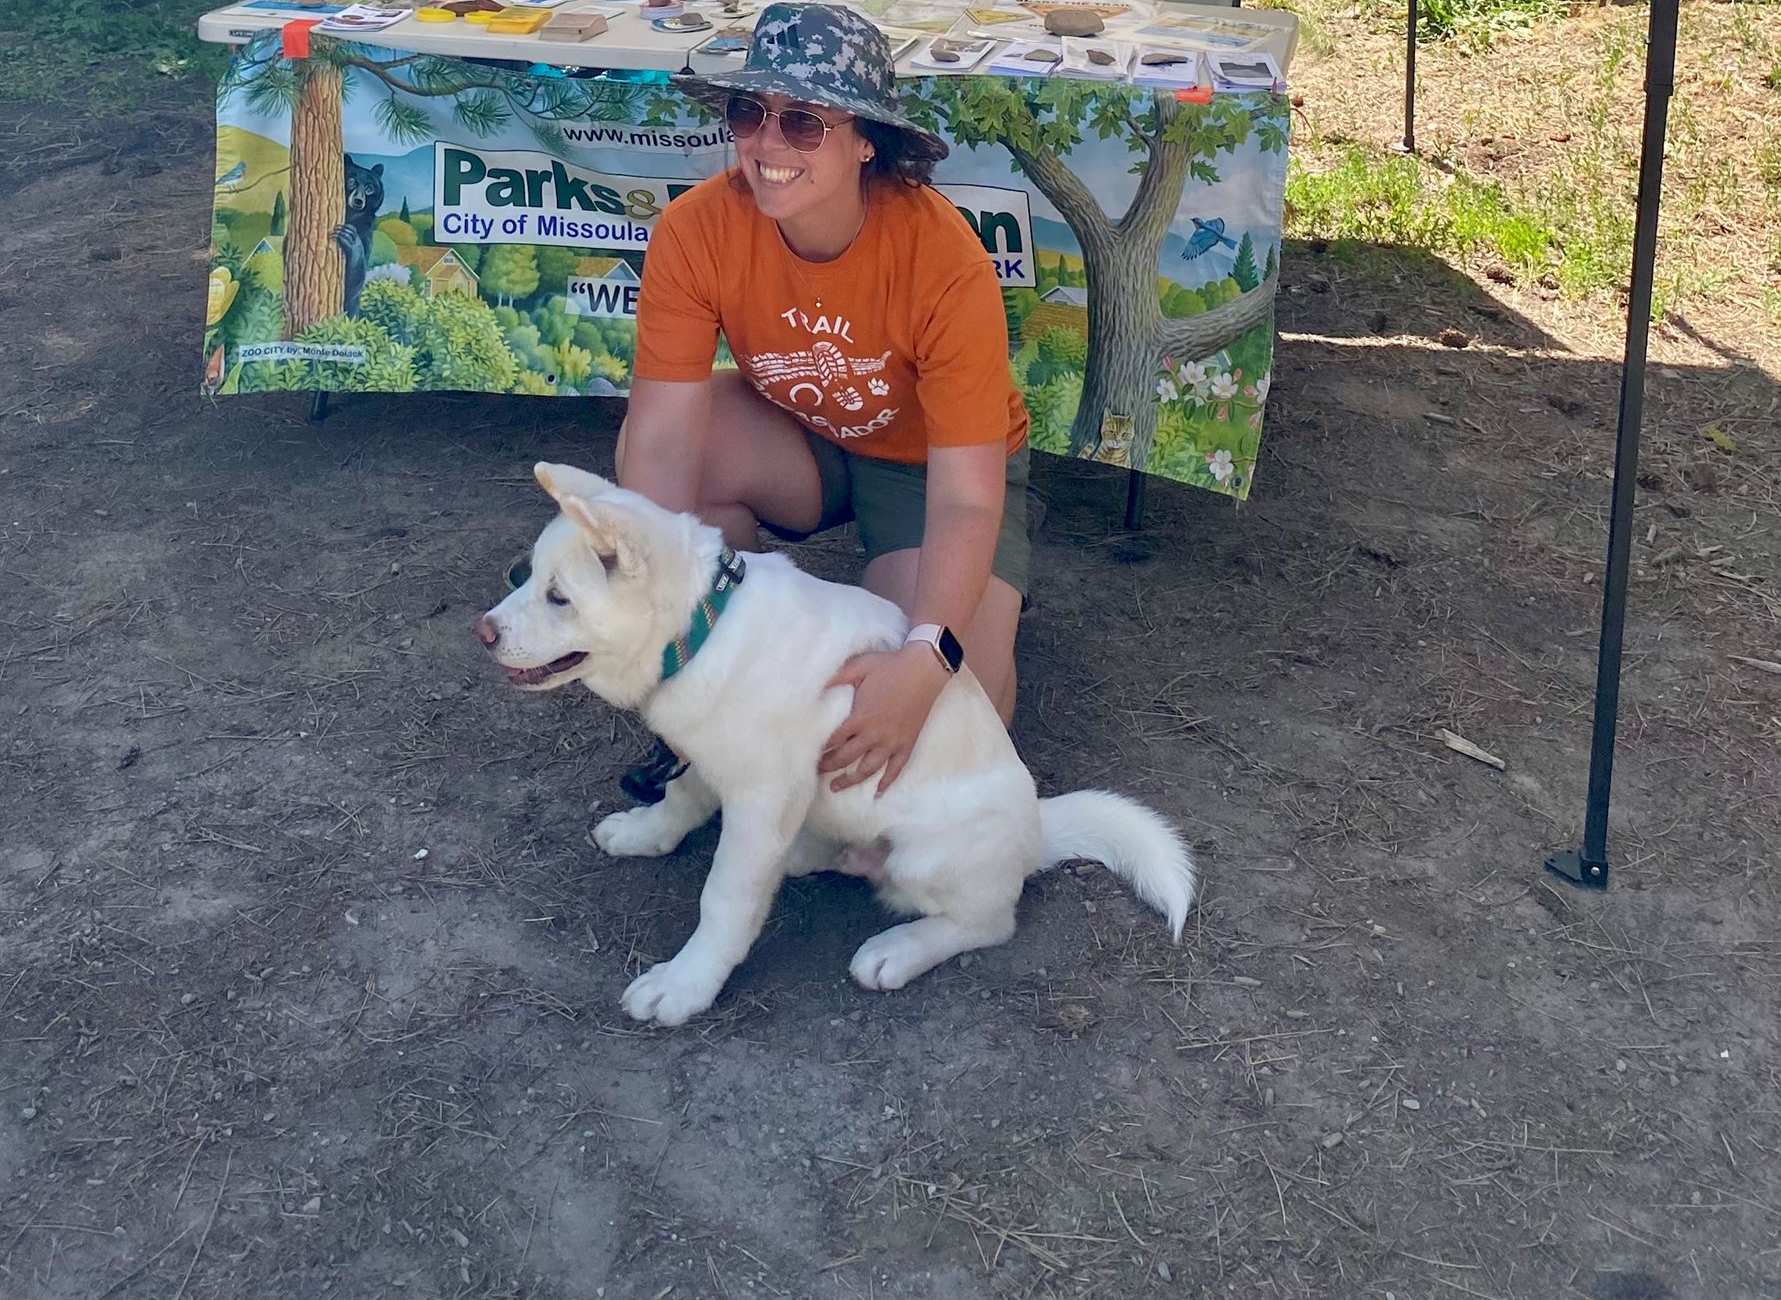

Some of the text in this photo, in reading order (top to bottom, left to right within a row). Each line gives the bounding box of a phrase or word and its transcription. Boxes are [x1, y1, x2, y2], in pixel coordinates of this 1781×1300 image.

[443, 213, 649, 242] City of Missoula
[781, 308, 853, 343] TRAIL
[241, 348, 262, 357] ZOO
[264, 346, 284, 355] CITY
[303, 347, 330, 356] Monte
[332, 348, 364, 358] Dolack
